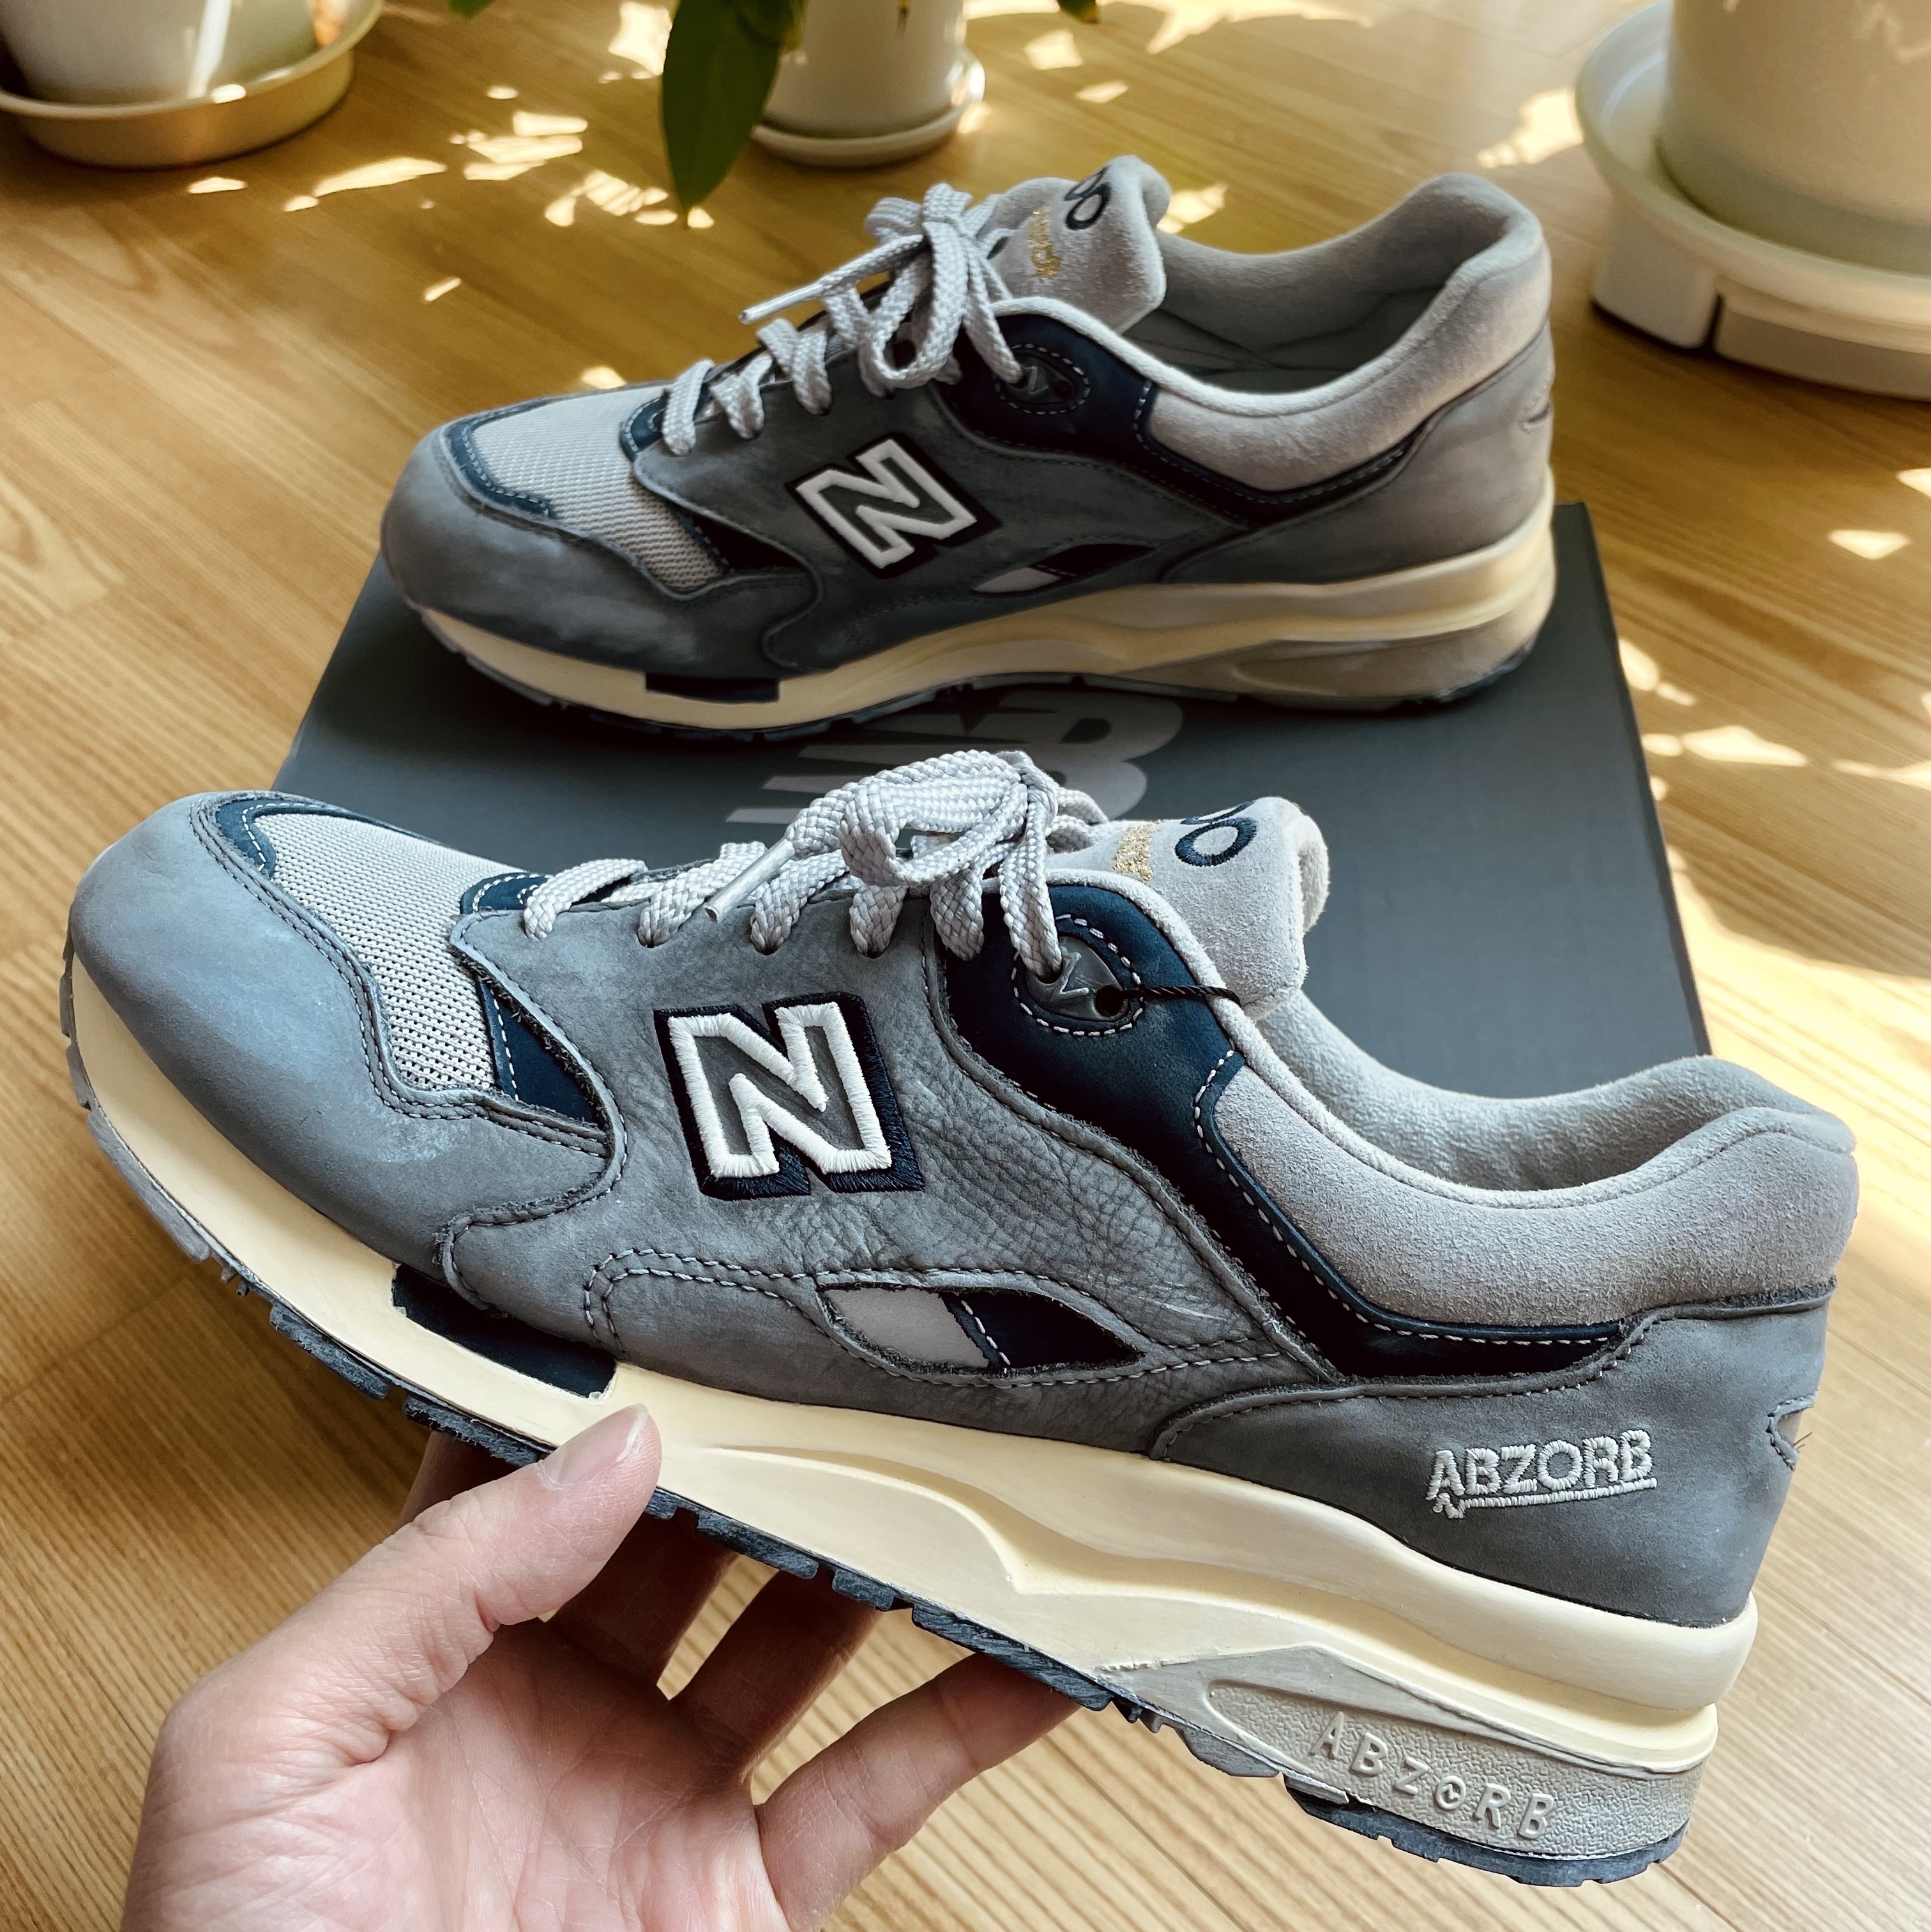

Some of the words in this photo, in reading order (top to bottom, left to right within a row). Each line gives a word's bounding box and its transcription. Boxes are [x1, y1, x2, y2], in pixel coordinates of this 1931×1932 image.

[789, 436, 991, 575] N
[660, 996, 910, 1192] N
[1425, 1429, 1655, 1502] ABZORB
[1309, 1710, 1556, 1840] ABZORB
